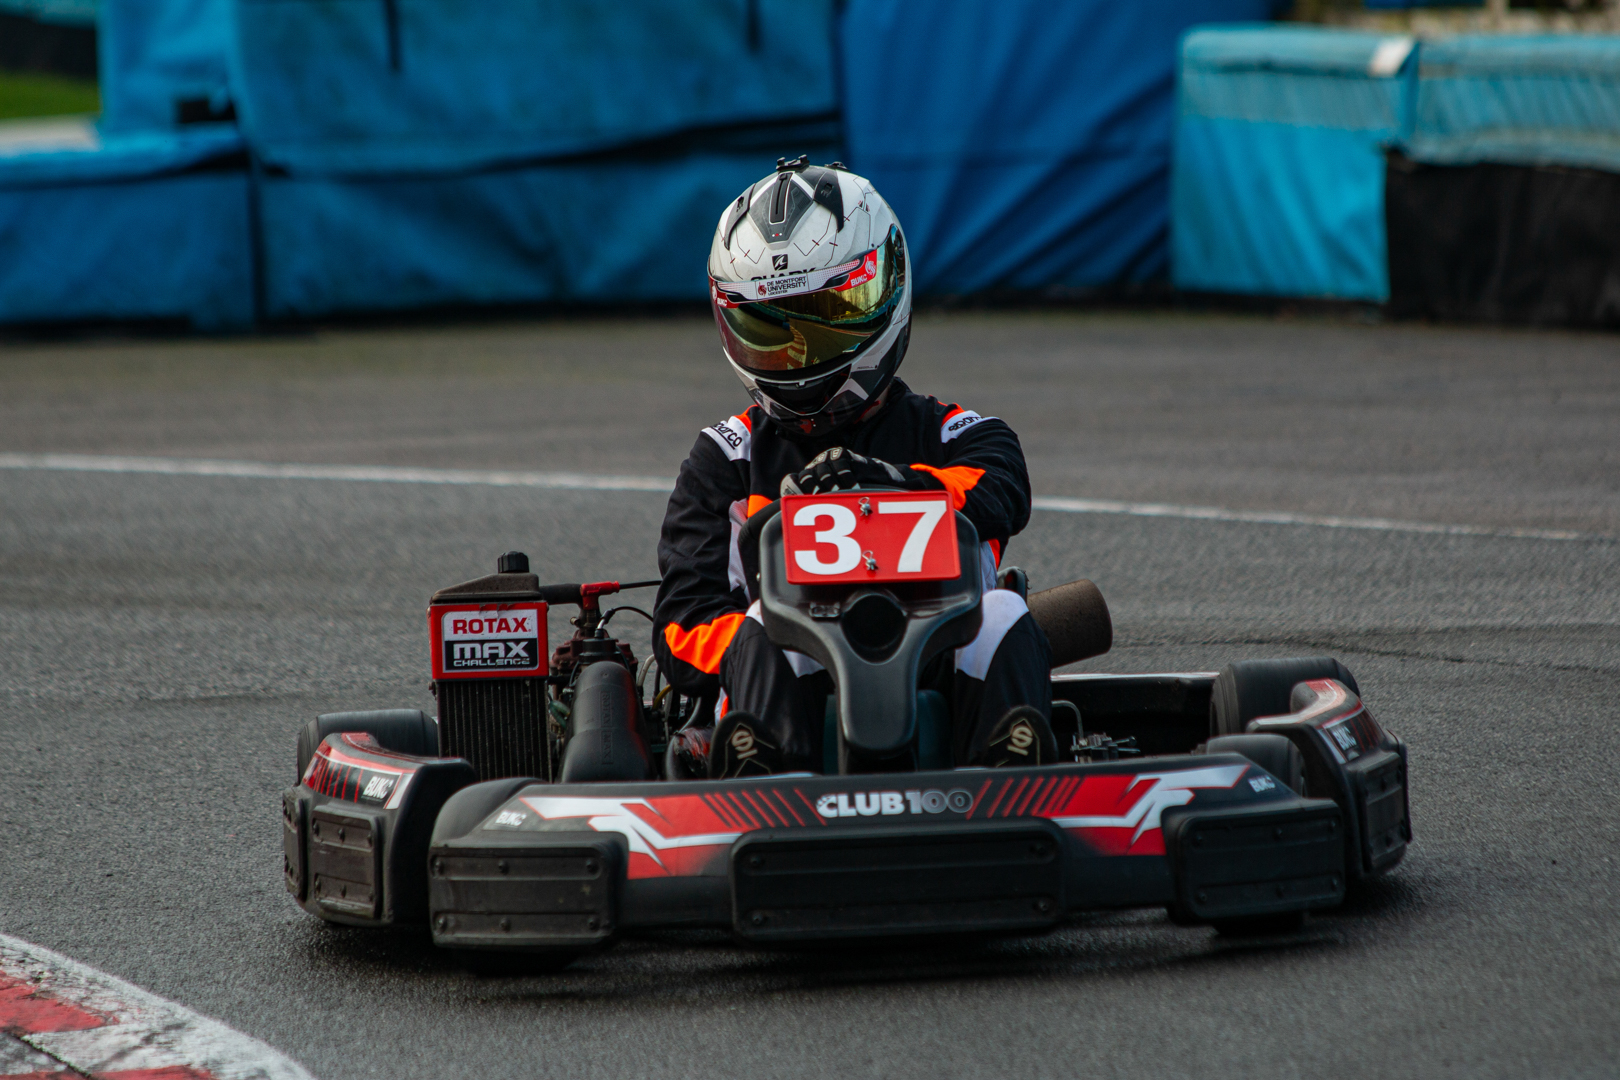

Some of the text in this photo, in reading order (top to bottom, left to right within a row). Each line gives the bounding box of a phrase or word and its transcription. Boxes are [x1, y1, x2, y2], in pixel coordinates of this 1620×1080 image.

[767, 281, 807, 292] UNIVERSITY
[775, 276, 806, 285] MONTFORT
[452, 617, 529, 635] ROTAX
[453, 641, 529, 659] MAX
[453, 658, 530, 667] CHALLENGE
[362, 776, 394, 799] BUKC
[495, 811, 527, 827] BUKC
